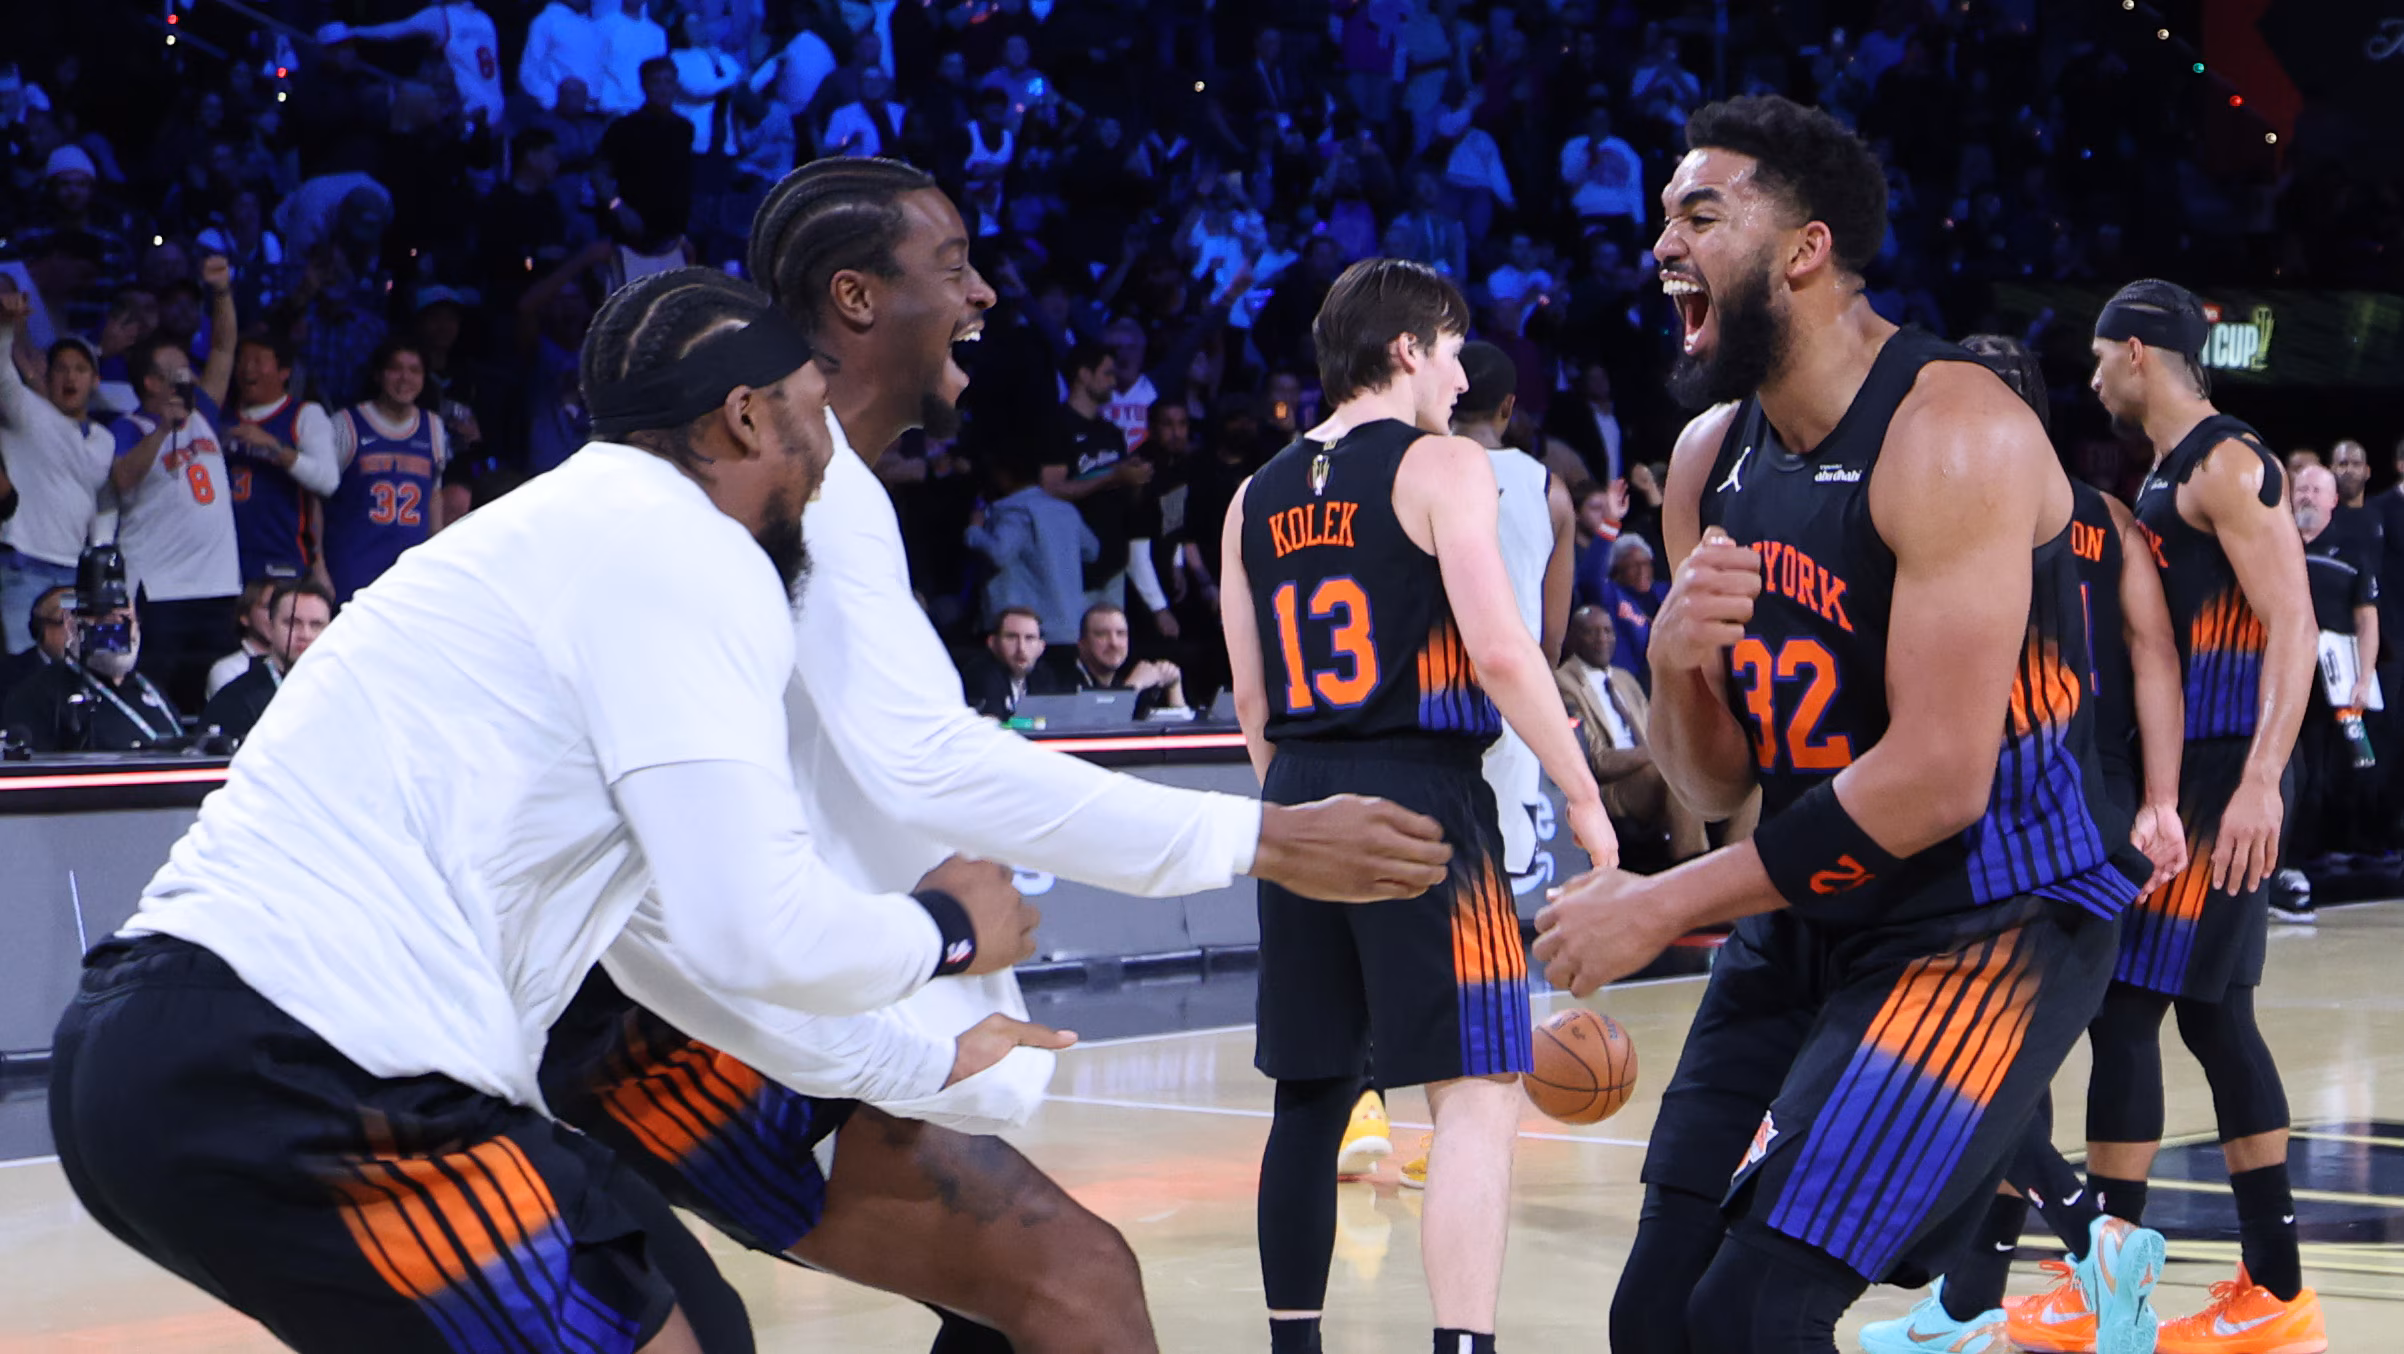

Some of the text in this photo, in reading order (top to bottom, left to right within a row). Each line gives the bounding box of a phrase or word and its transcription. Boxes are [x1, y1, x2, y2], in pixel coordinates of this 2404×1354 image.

[2213, 323, 2258, 368] CUP
[186, 463, 215, 504] 8
[369, 481, 421, 525] 32
[1268, 500, 1359, 559] KOLEK
[1272, 574, 1382, 714] 13
[1731, 633, 1853, 774] 32
